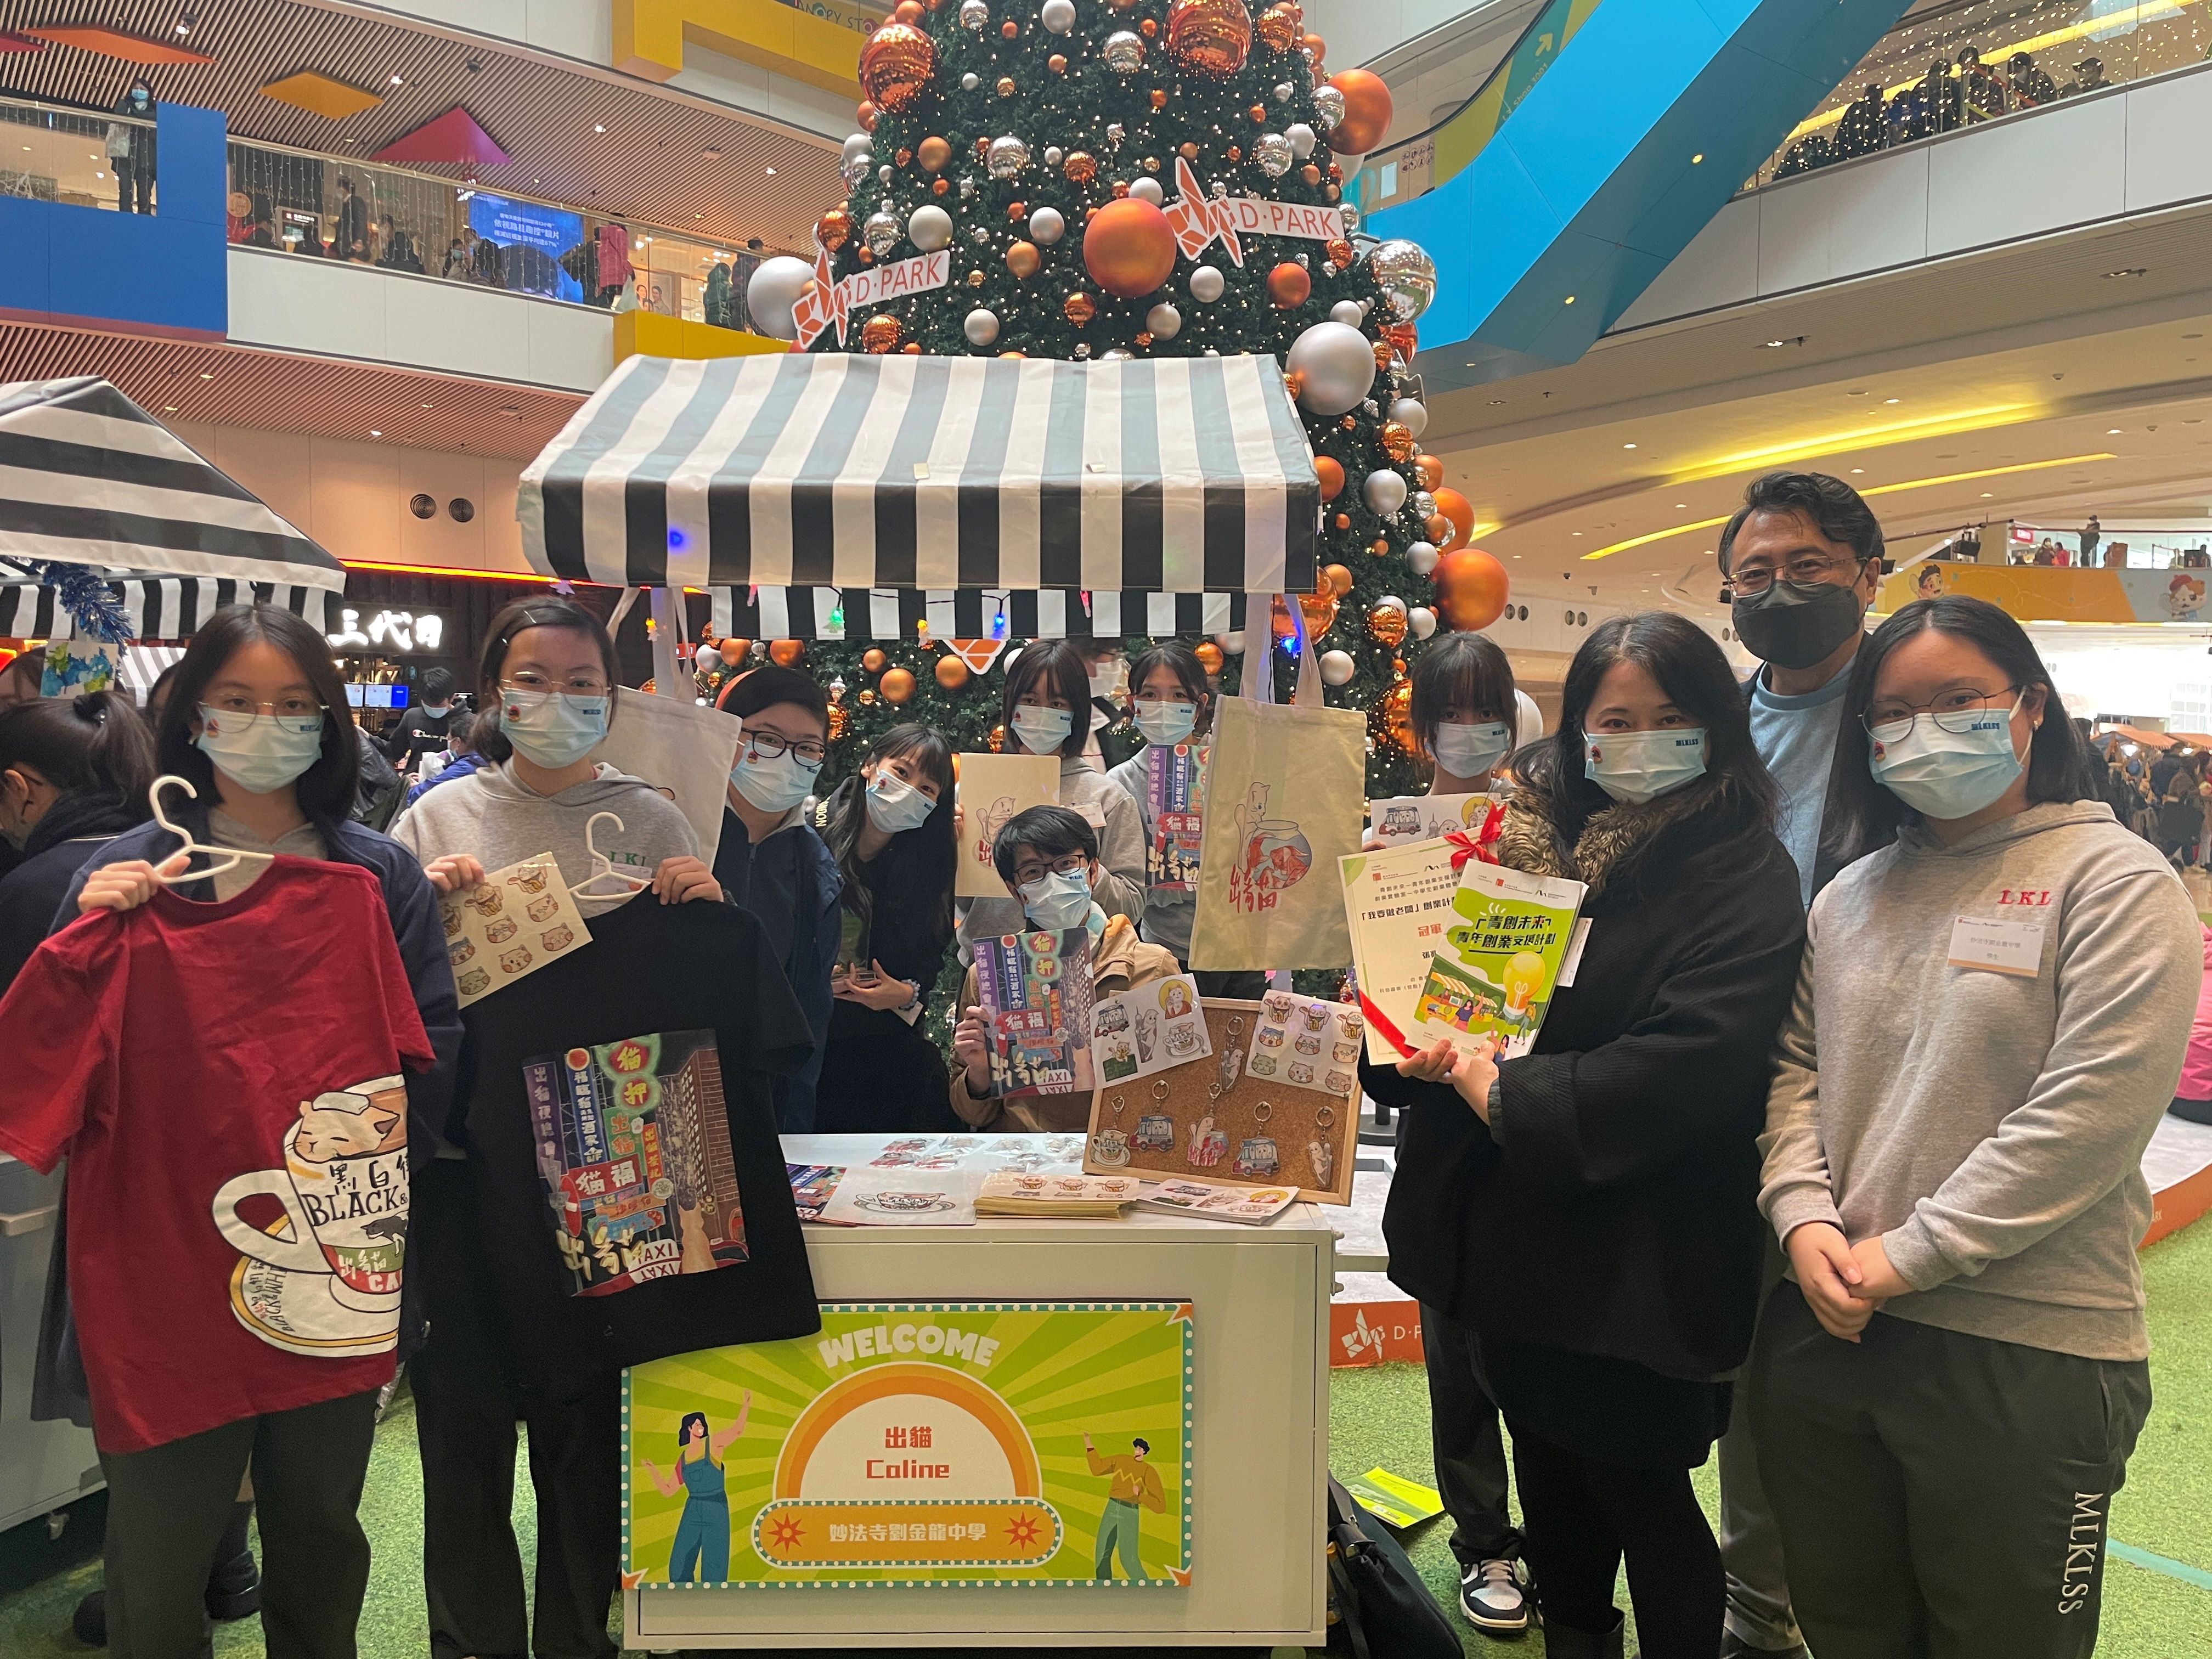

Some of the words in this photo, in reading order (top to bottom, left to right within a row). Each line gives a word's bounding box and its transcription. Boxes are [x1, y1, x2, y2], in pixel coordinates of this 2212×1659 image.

[978, 840, 992, 867] 出
[1997, 889, 2051, 906] LKL
[1457, 932, 1556, 949] 青年創業支援計劃
[301, 1185, 399, 1227] BLACK
[368, 1272, 402, 1291] CA
[1394, 1325, 1422, 1340] D·P
[817, 1323, 1001, 1369] WELCOME
[885, 1426, 932, 1449] 出貓
[866, 1459, 950, 1479] Caline
[829, 1522, 986, 1543] 妙法寺劉金龍中學
[2058, 1491, 2103, 1615] MLKLSS
